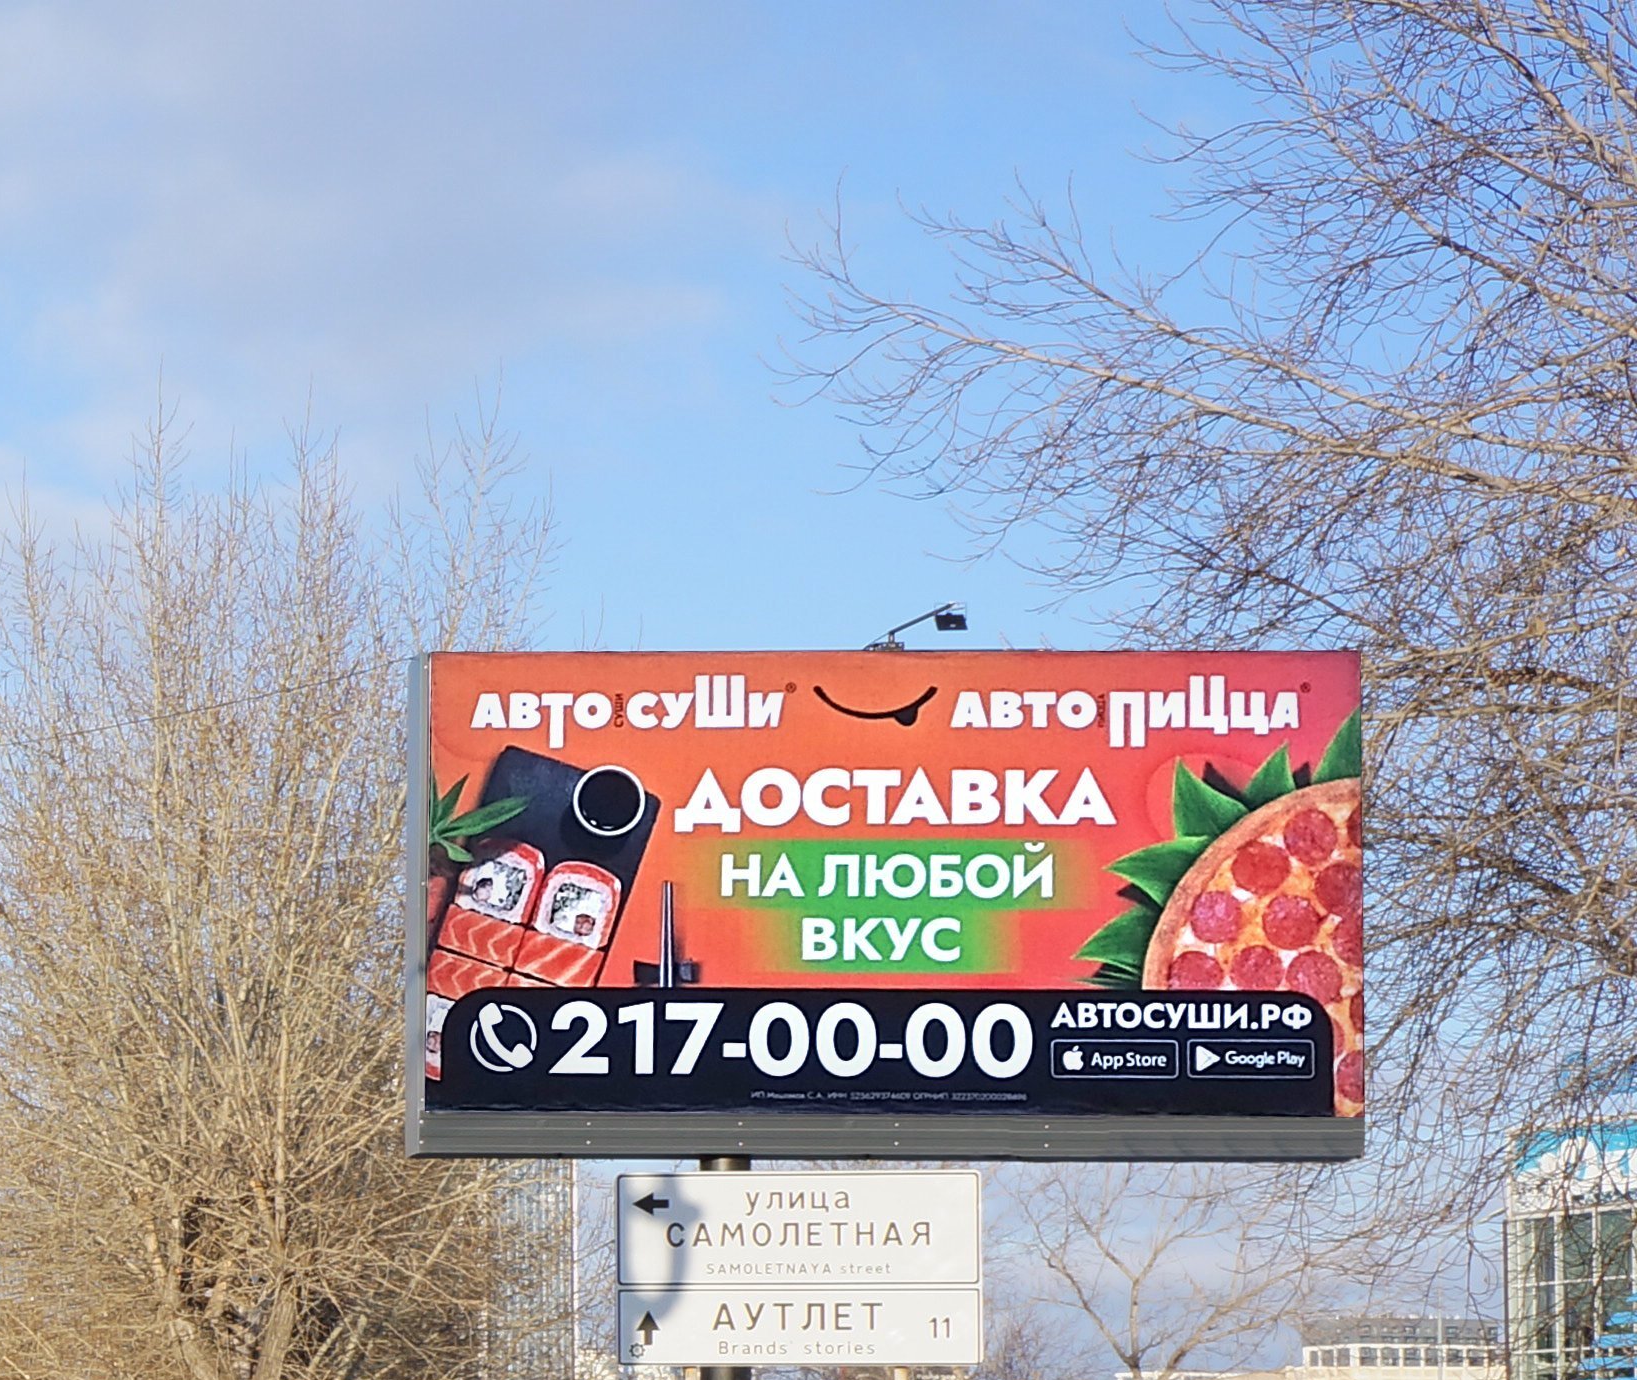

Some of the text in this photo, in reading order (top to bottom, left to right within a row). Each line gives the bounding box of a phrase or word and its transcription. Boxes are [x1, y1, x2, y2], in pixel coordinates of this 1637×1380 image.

[470, 691, 613, 749] АВТО
[950, 691, 1098, 729] АВТО
[674, 766, 1117, 833] ДОСТАВКА
[720, 842, 1054, 899] НА ЛЮБОЙ
[801, 917, 961, 962] ВКУС
[1050, 1002, 1313, 1030] АВТОСУШИ.РФ
[548, 1000, 1033, 1079] 217-00-00
[1090, 1051, 1167, 1068] App Store
[1225, 1051, 1306, 1068] Google Play
[745, 1191, 850, 1216] улица
[666, 1222, 931, 1247] САМОЛЕТНАЯ
[706, 1262, 892, 1275] SAMOLETNAYA street
[712, 1303, 951, 1339] АУТЛЕТ 11
[804, 1341, 875, 1356] stories
